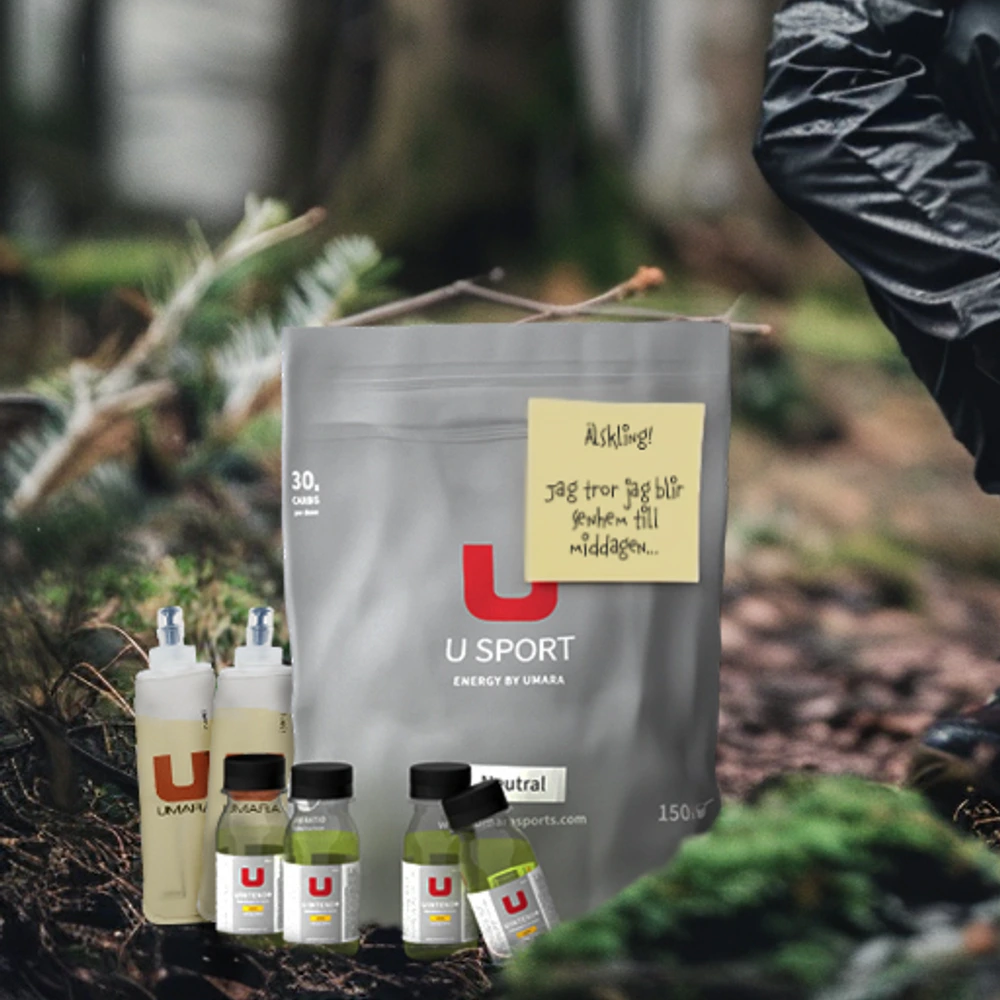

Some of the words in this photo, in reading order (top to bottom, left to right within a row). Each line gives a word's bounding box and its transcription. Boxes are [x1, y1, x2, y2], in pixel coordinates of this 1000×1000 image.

[584, 422, 653, 450] Älskling!
[545, 480, 578, 503] Jag
[583, 480, 618, 500] tror
[623, 477, 651, 511] jag
[655, 475, 684, 500] blir
[633, 504, 659, 530] till
[446, 638, 467, 663] U
[475, 635, 576, 663] SPORT
[453, 676, 500, 687] ENERGY
[504, 676, 519, 686] BY
[523, 674, 565, 686] UMARA
[481, 775, 546, 793] utral
[241, 867, 265, 888] U
[308, 876, 333, 898] U
[428, 876, 453, 898] U
[501, 889, 528, 915] U
